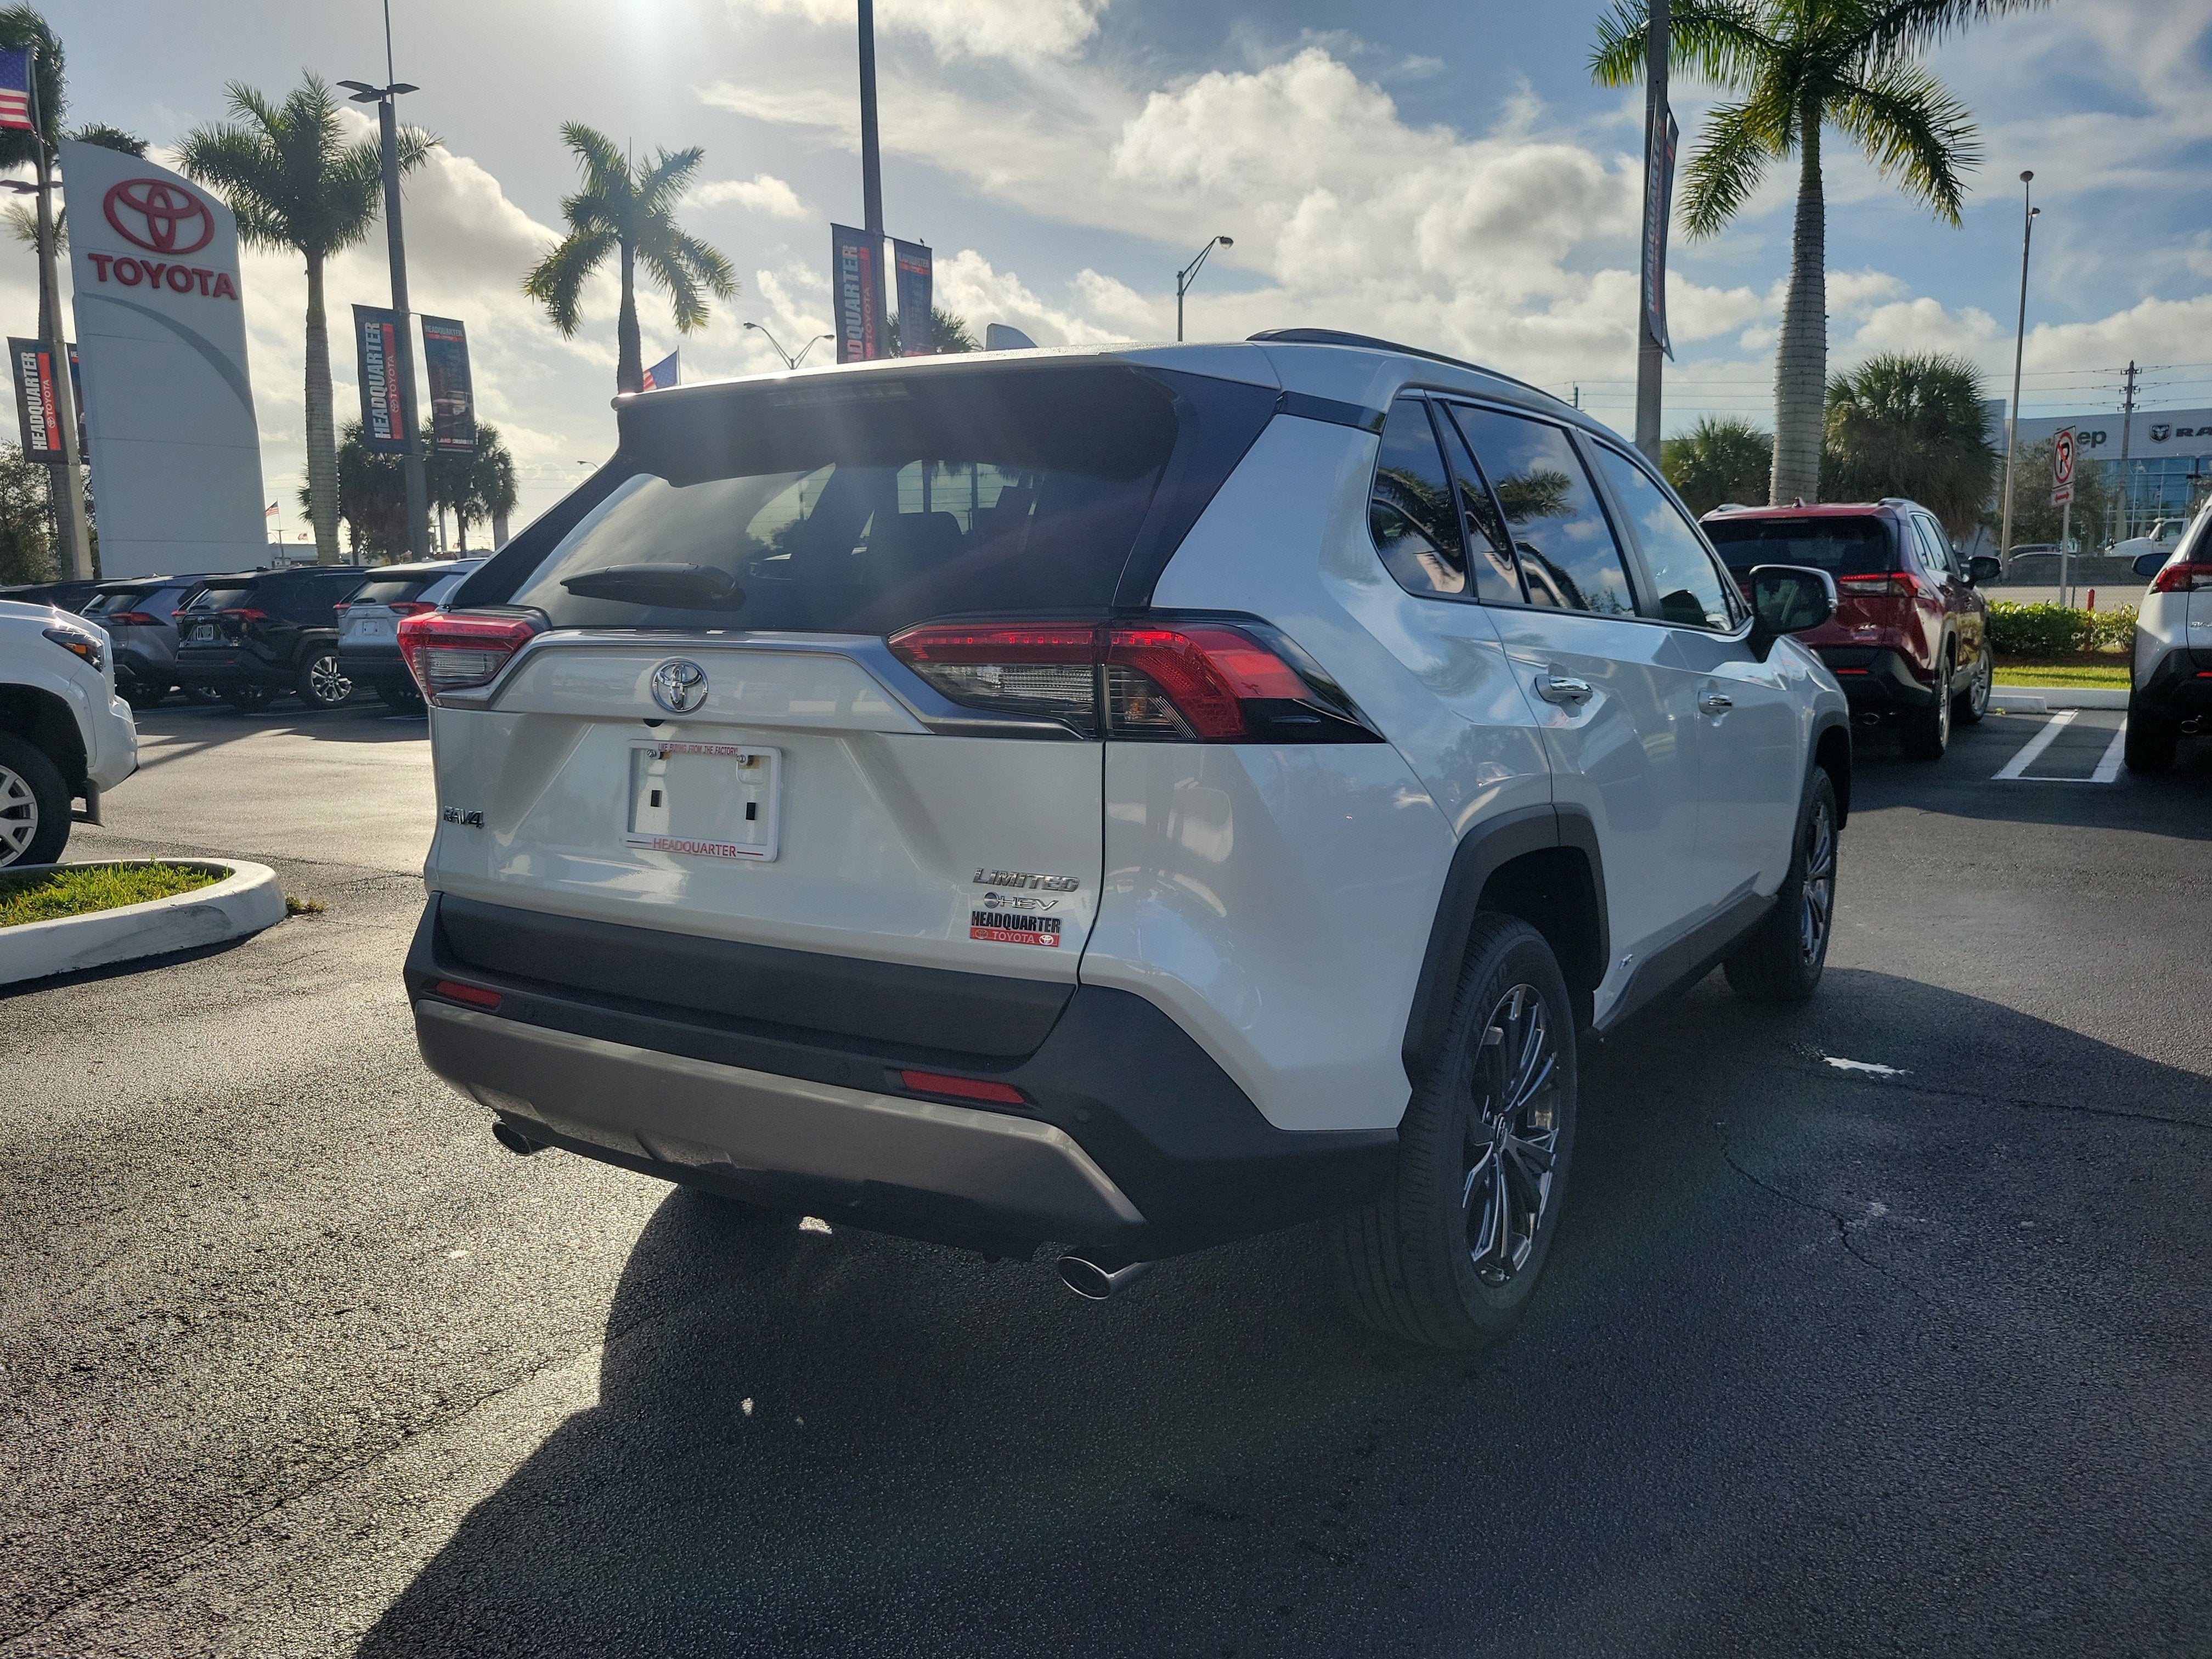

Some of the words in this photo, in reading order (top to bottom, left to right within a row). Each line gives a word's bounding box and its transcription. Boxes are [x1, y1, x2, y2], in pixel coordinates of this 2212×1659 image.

[88, 253, 238, 300] TOYOTA
[842, 245, 865, 362] ADQUARTER
[365, 322, 391, 439] HEADQUARTER
[387, 356, 399, 398] TOYOTA
[21, 352, 48, 450] HEADQUARTER
[43, 379, 56, 416] TOYOTA
[658, 743, 668, 752] LIKE
[688, 745, 702, 754] FROM
[703, 746, 713, 754] THE
[715, 746, 738, 756] FACTORY!
[444, 805, 484, 829] RAV4
[653, 837, 737, 857] HEADQUARTER
[972, 867, 1080, 893] LIMITED
[971, 911, 1061, 934] HEADQUARTER
[992, 931, 1035, 944] TOYOTA
